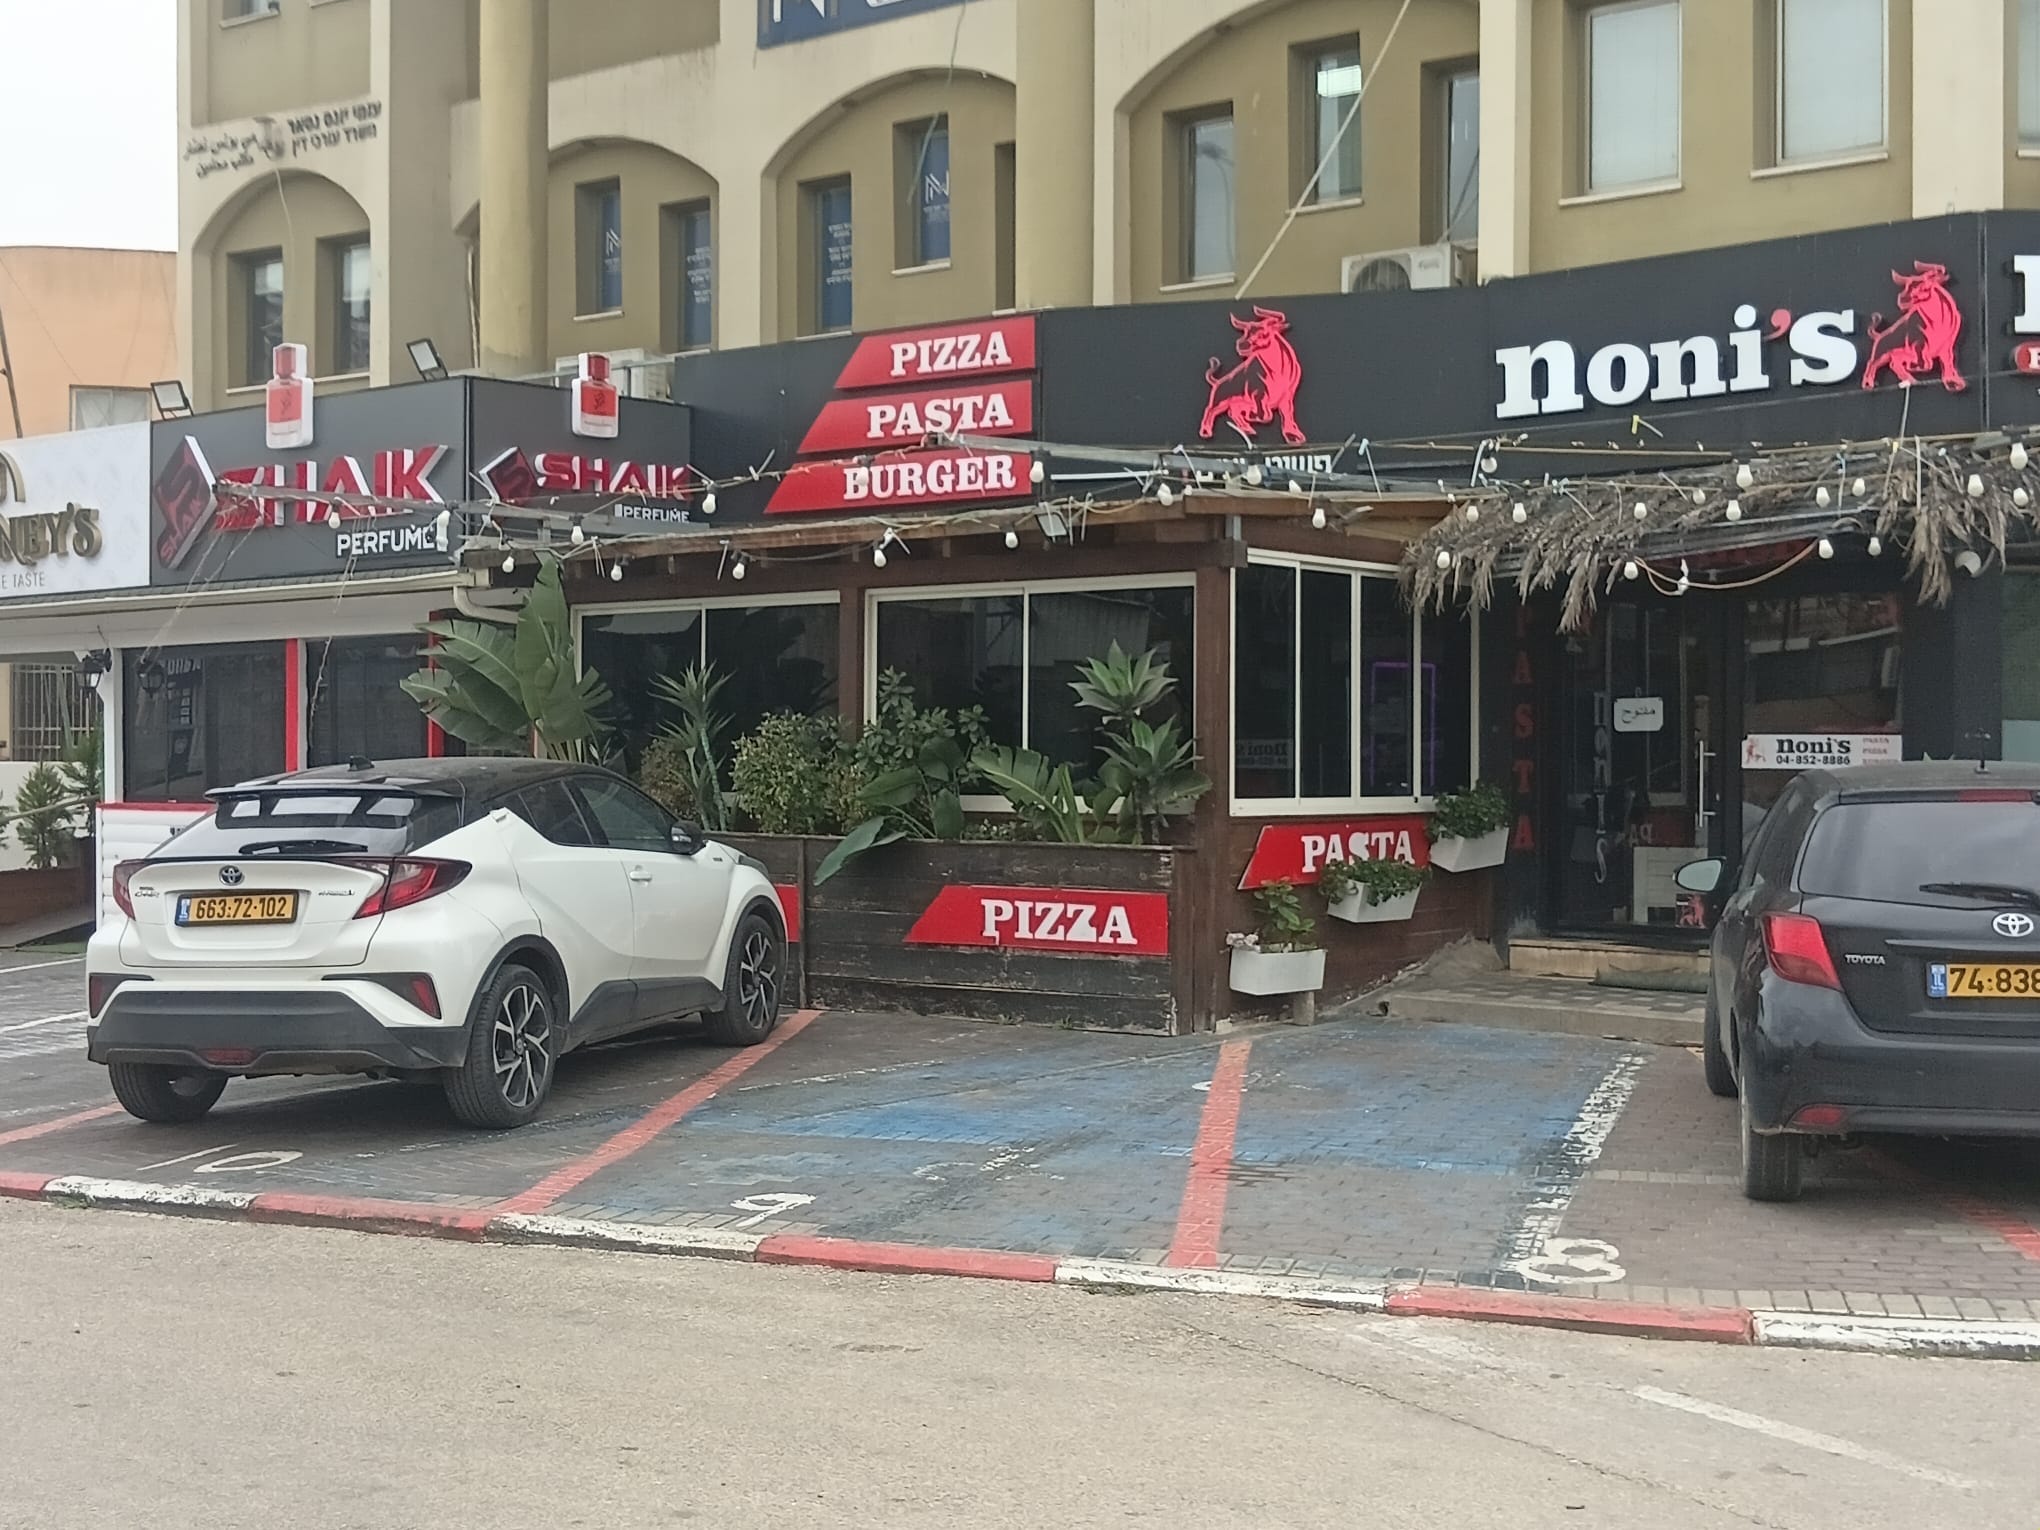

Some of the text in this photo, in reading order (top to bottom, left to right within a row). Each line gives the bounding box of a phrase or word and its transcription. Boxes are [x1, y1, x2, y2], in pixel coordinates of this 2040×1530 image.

[890, 330, 1013, 377] PIZZA
[1496, 304, 1858, 419] noni's
[866, 393, 1014, 440] PASTA
[534, 452, 692, 502] SHAIK
[843, 453, 1018, 501] BURGER
[622, 504, 690, 522] PERFUME
[13, 570, 46, 588] TASTE
[1621, 706, 1656, 724] مفتوح
[1776, 737, 1851, 754] noni's
[1300, 830, 1415, 874] PASTA
[980, 898, 1138, 945] PIZZA
[1845, 955, 1886, 965] TOYOTA
[1518, 1237, 1627, 1284] 8
